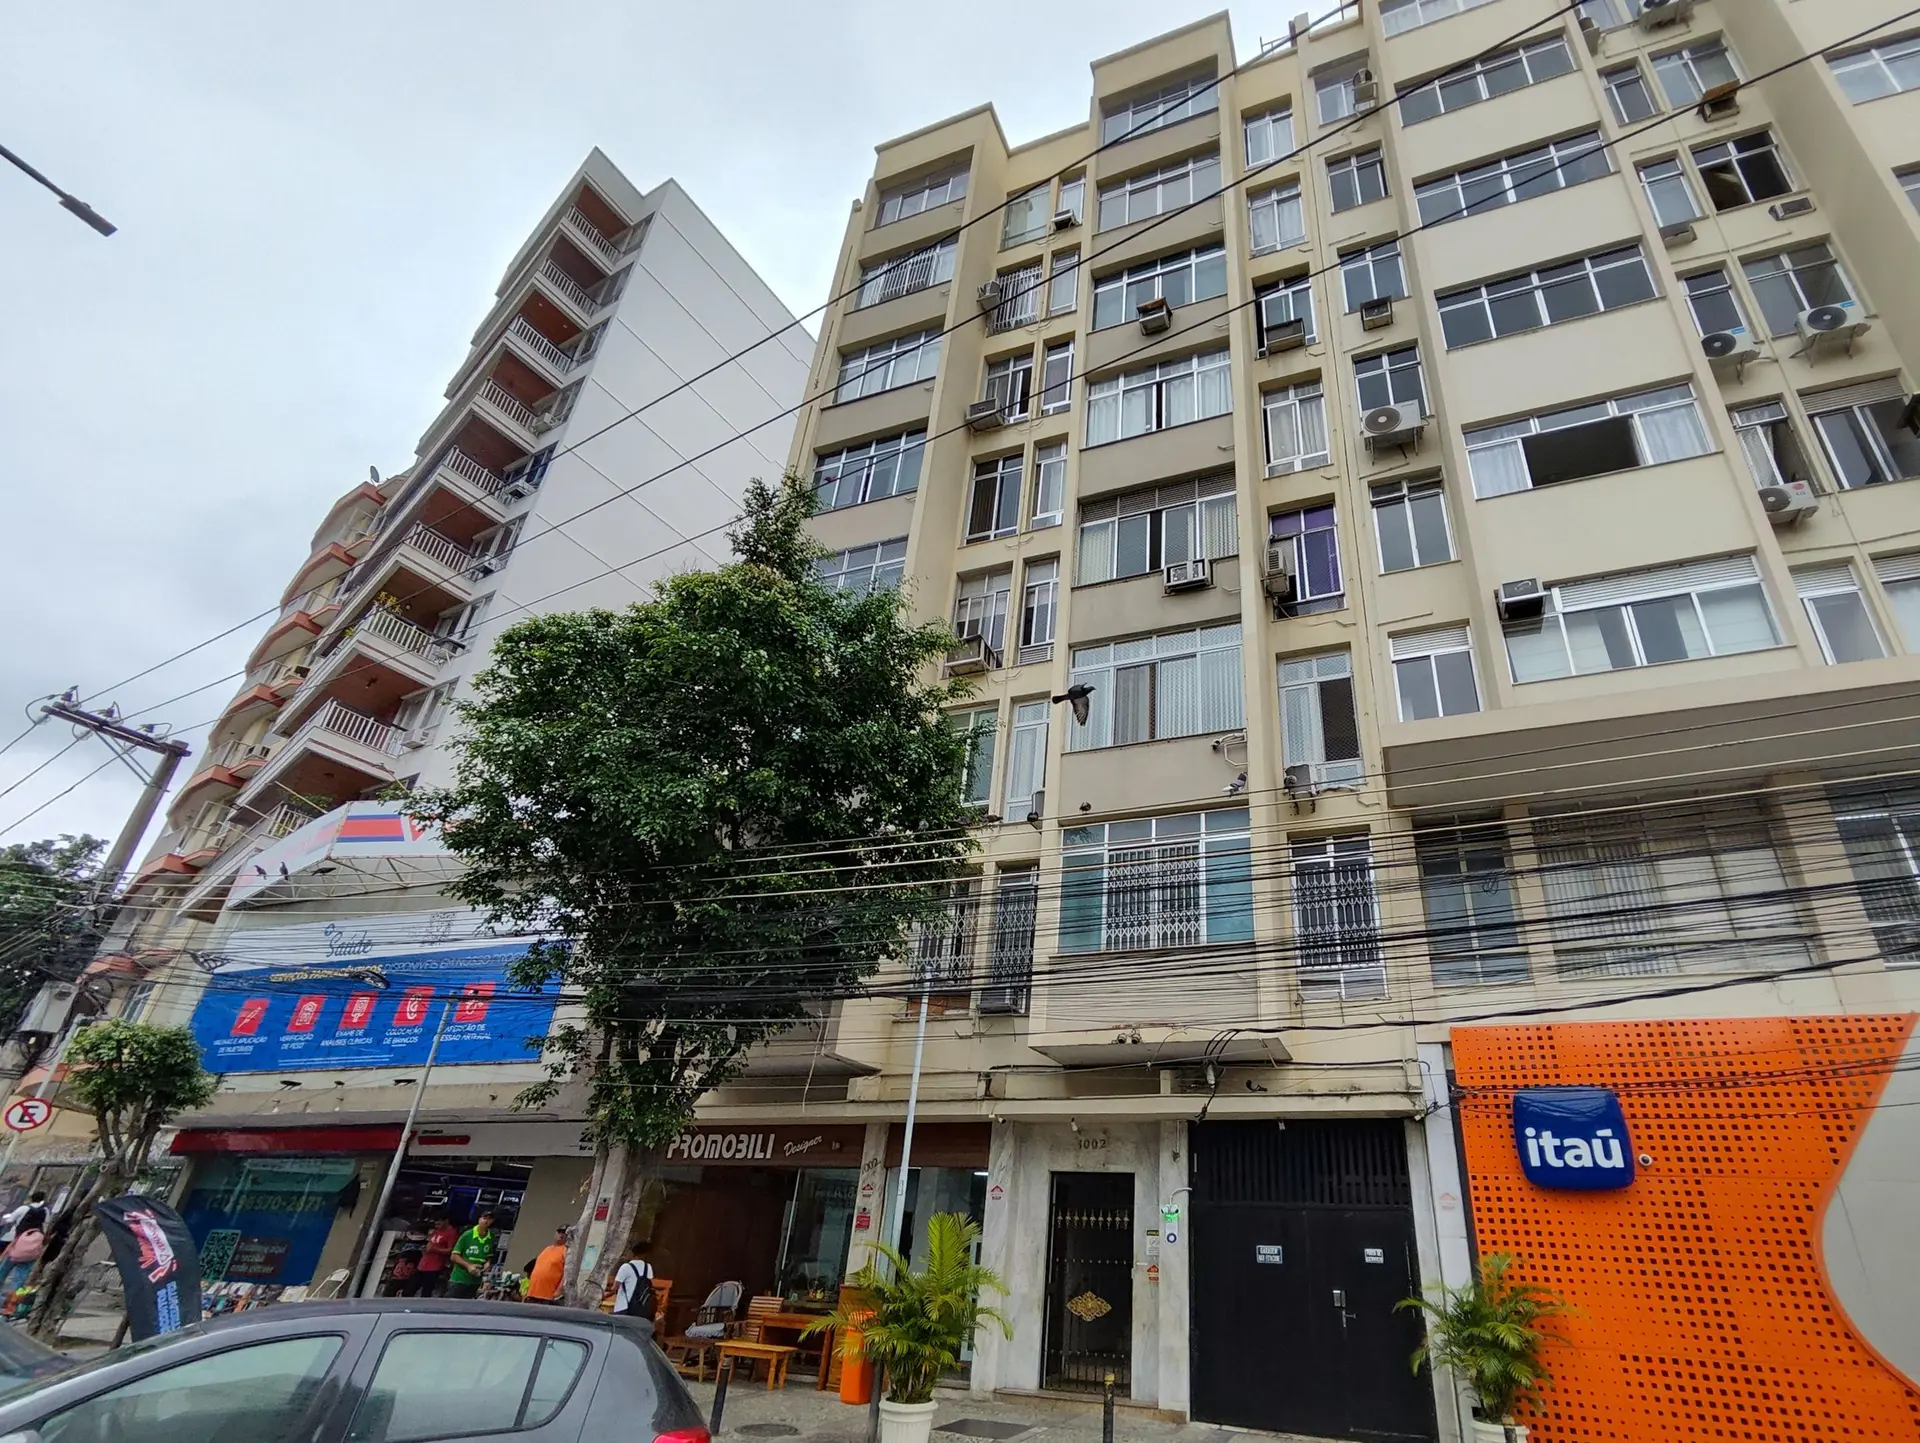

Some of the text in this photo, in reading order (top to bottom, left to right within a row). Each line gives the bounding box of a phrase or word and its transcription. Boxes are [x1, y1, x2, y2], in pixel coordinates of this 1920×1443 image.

[18, 1106, 40, 1123] E
[666, 1133, 775, 1159] PROMOBILI
[784, 1135, 823, 1157] Designer
[1078, 1139, 1107, 1149] 1002
[1524, 1127, 1625, 1169] itaú
